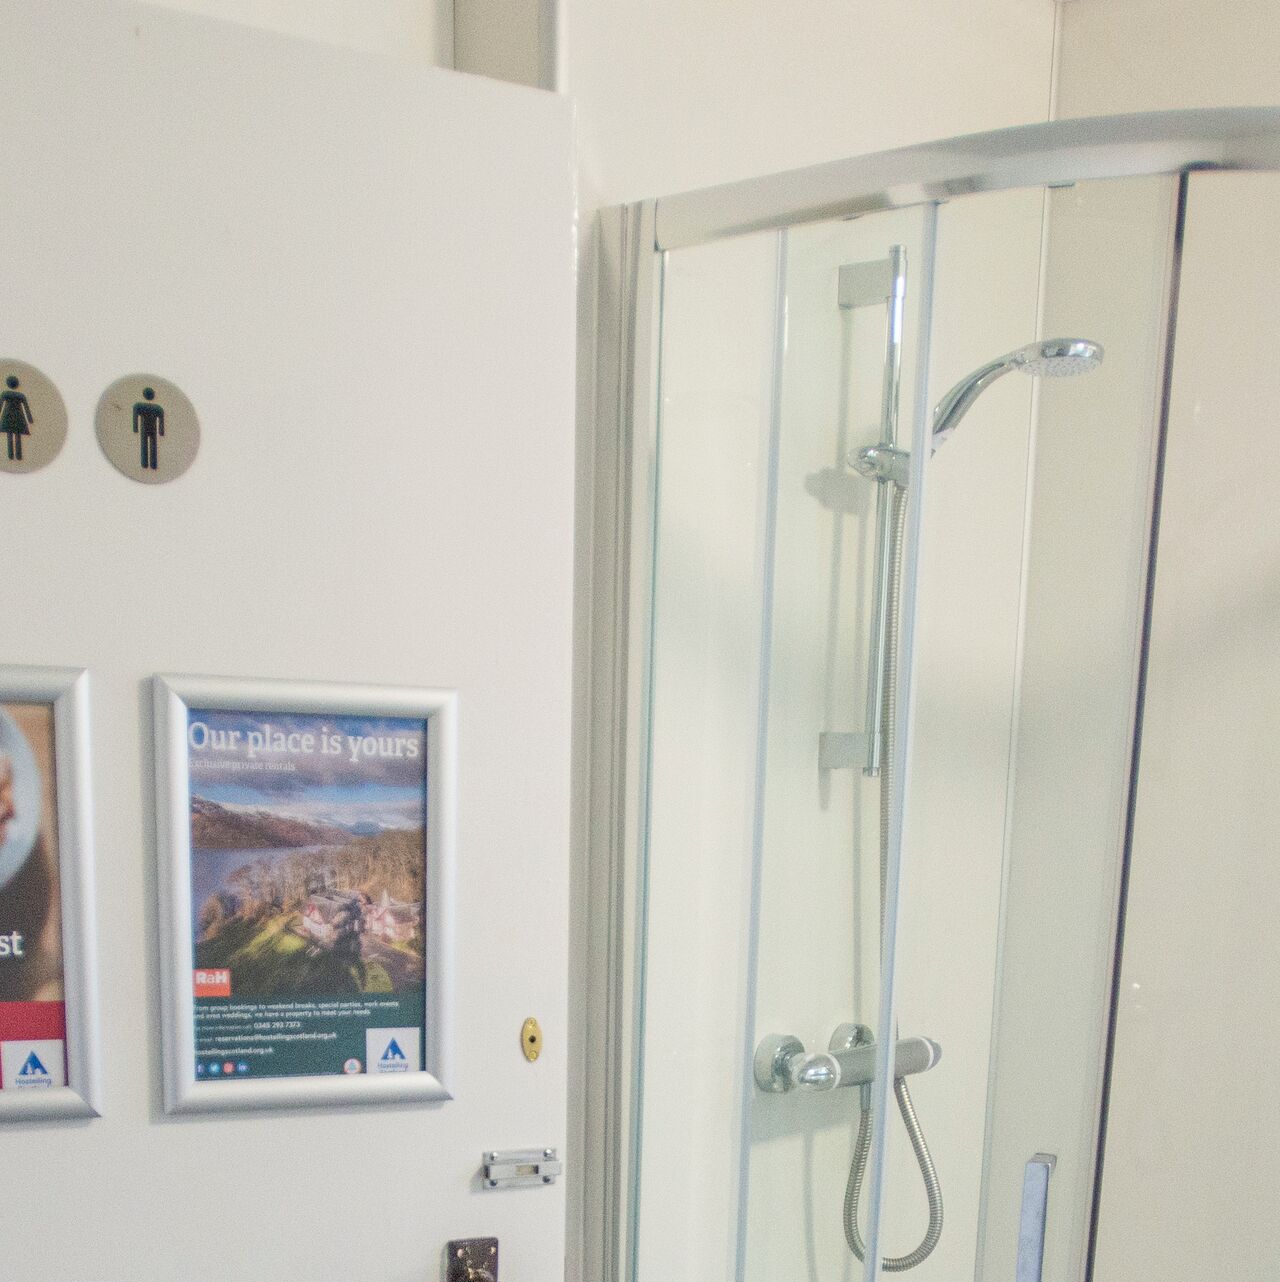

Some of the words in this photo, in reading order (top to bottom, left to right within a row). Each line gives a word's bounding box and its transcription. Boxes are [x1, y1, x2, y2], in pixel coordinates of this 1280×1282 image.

[189, 722, 241, 750] Our
[247, 724, 315, 758] place
[321, 728, 342, 755] is
[348, 735, 418, 762] yours
[229, 1003, 257, 1012] bookings
[267, 1002, 294, 1010] weekend
[285, 1010, 312, 1019] property
